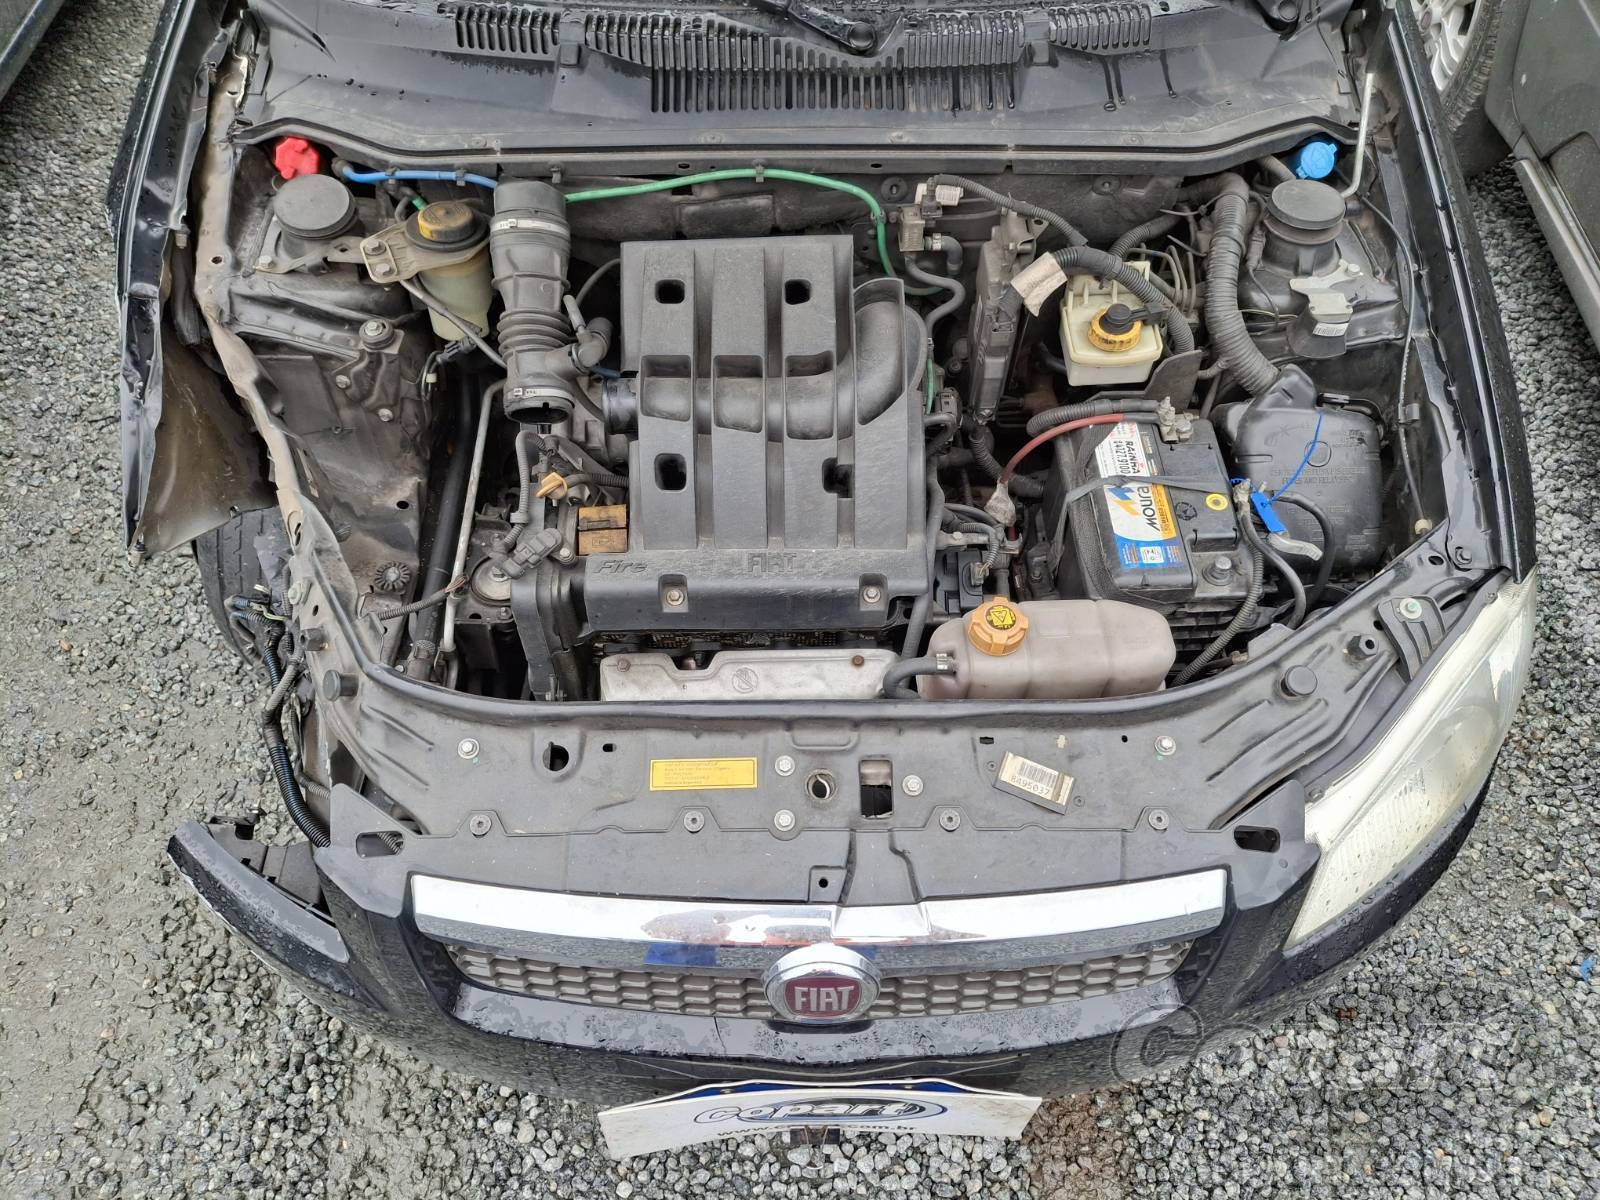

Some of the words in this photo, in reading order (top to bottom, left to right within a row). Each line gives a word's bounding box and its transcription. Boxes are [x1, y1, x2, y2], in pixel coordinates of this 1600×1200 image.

[594, 559, 648, 574] Fire
[748, 552, 798, 573] FIAT
[1010, 775, 1050, 796] 8495037
[794, 986, 855, 1011] FIAT
[694, 1102, 912, 1123] Copart
